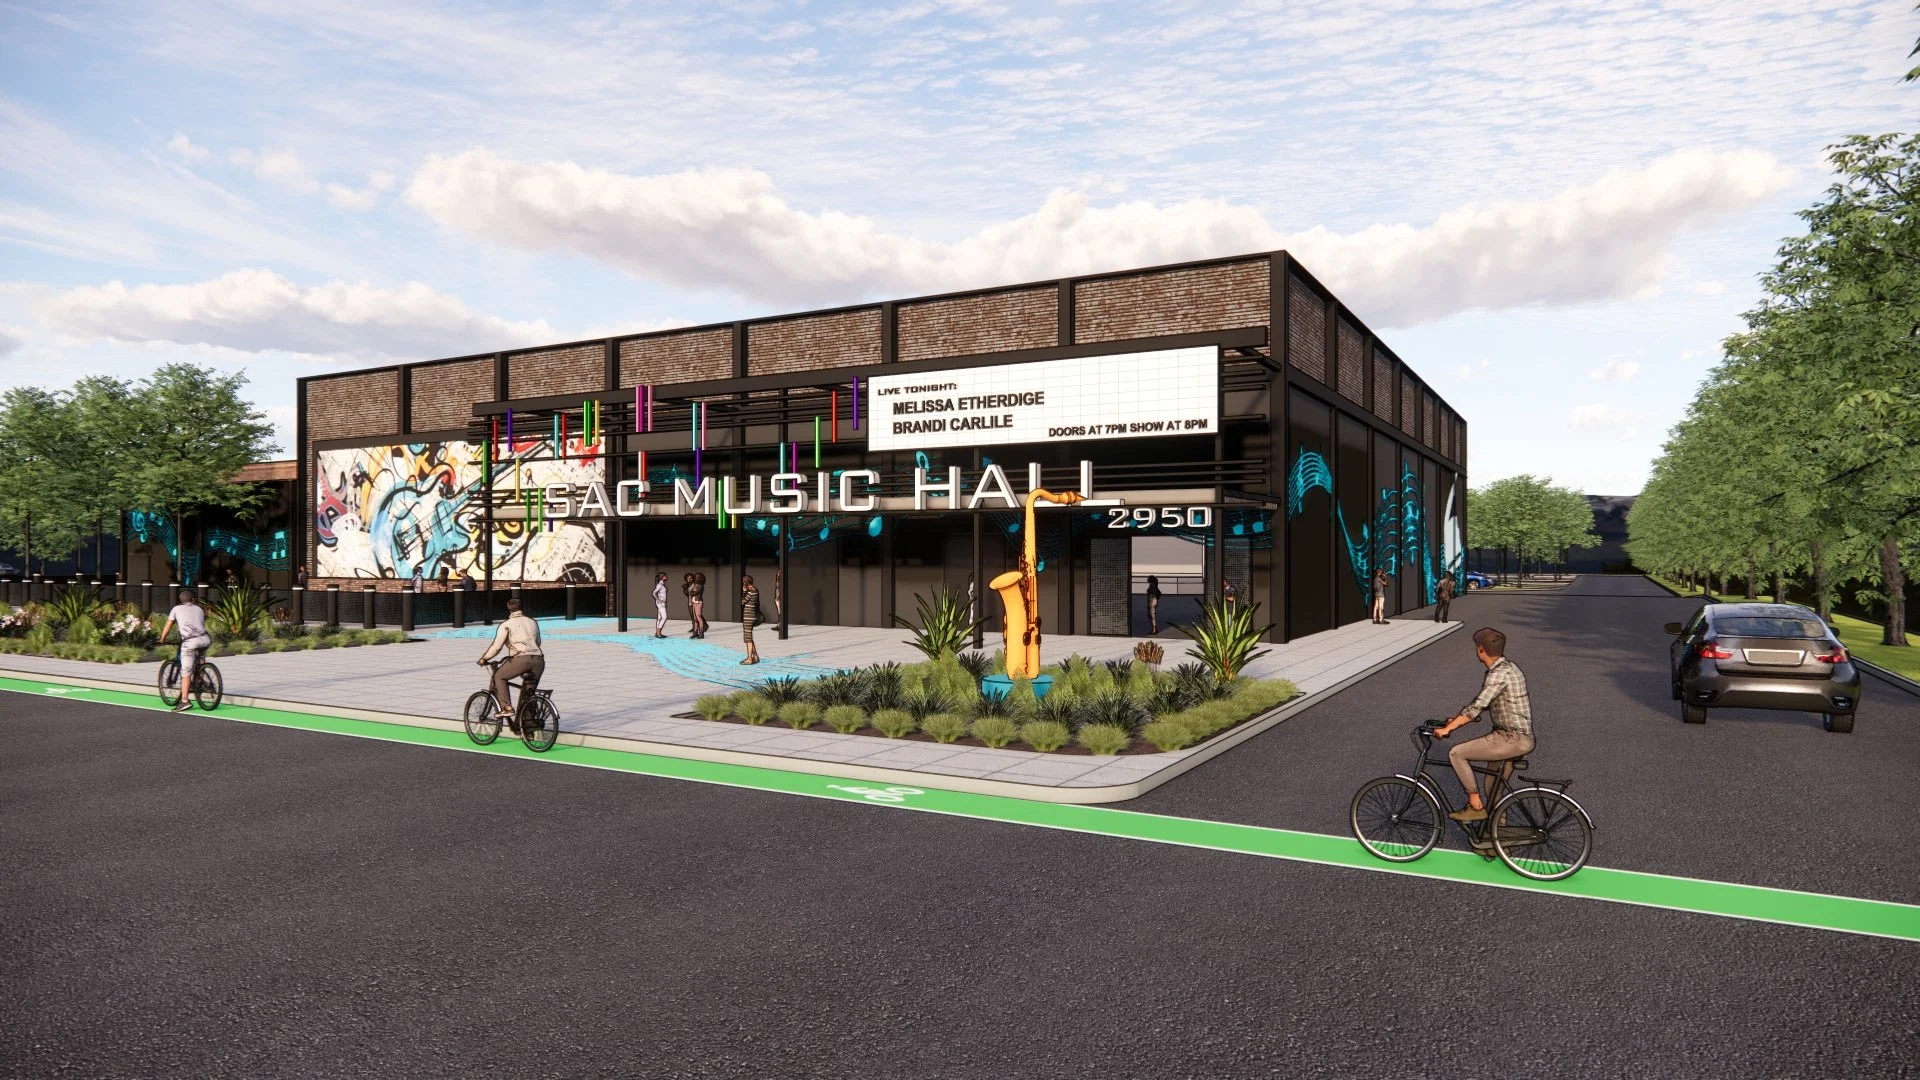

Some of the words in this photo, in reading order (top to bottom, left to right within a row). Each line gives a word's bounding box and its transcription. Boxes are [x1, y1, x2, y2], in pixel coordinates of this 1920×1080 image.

[877, 387, 901, 397] LIVE
[903, 382, 958, 394] TONIGHT:
[892, 397, 955, 416] MELISSA
[958, 391, 1045, 411] ETHERDIGE
[892, 418, 947, 435] BRANDI
[950, 414, 1014, 432] CARLILE
[1048, 425, 1086, 437] DOORS
[1087, 424, 1103, 436] AT
[1104, 423, 1128, 435] 7PM
[1129, 421, 1164, 433] SHOW
[1165, 420, 1182, 431] AT
[1184, 418, 1208, 430] 8PM
[545, 480, 651, 518] SAC
[673, 469, 880, 516] MUSIC
[914, 460, 1125, 511] HALL
[1107, 506, 1212, 529] 2950
